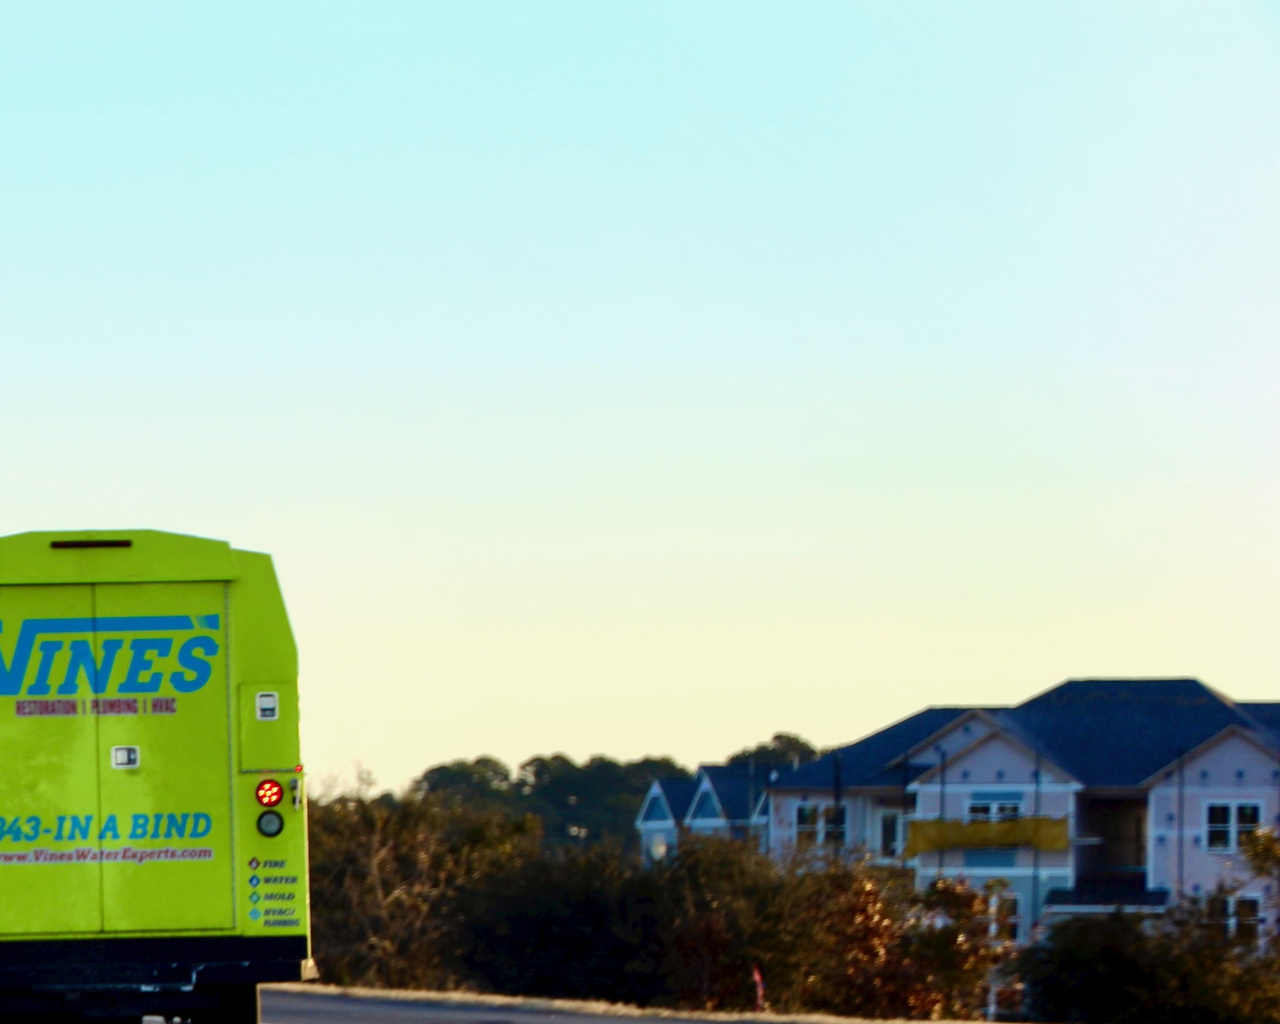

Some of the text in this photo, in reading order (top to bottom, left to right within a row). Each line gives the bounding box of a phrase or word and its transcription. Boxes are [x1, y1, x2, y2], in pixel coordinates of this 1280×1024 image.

[16, 698, 177, 716] RESTORATION PLUMBING HVAC
[97, 814, 121, 841] A
[128, 812, 213, 840] BIND
[263, 859, 287, 869] FIRE
[264, 875, 298, 884] WATER
[264, 892, 296, 901] MOLD
